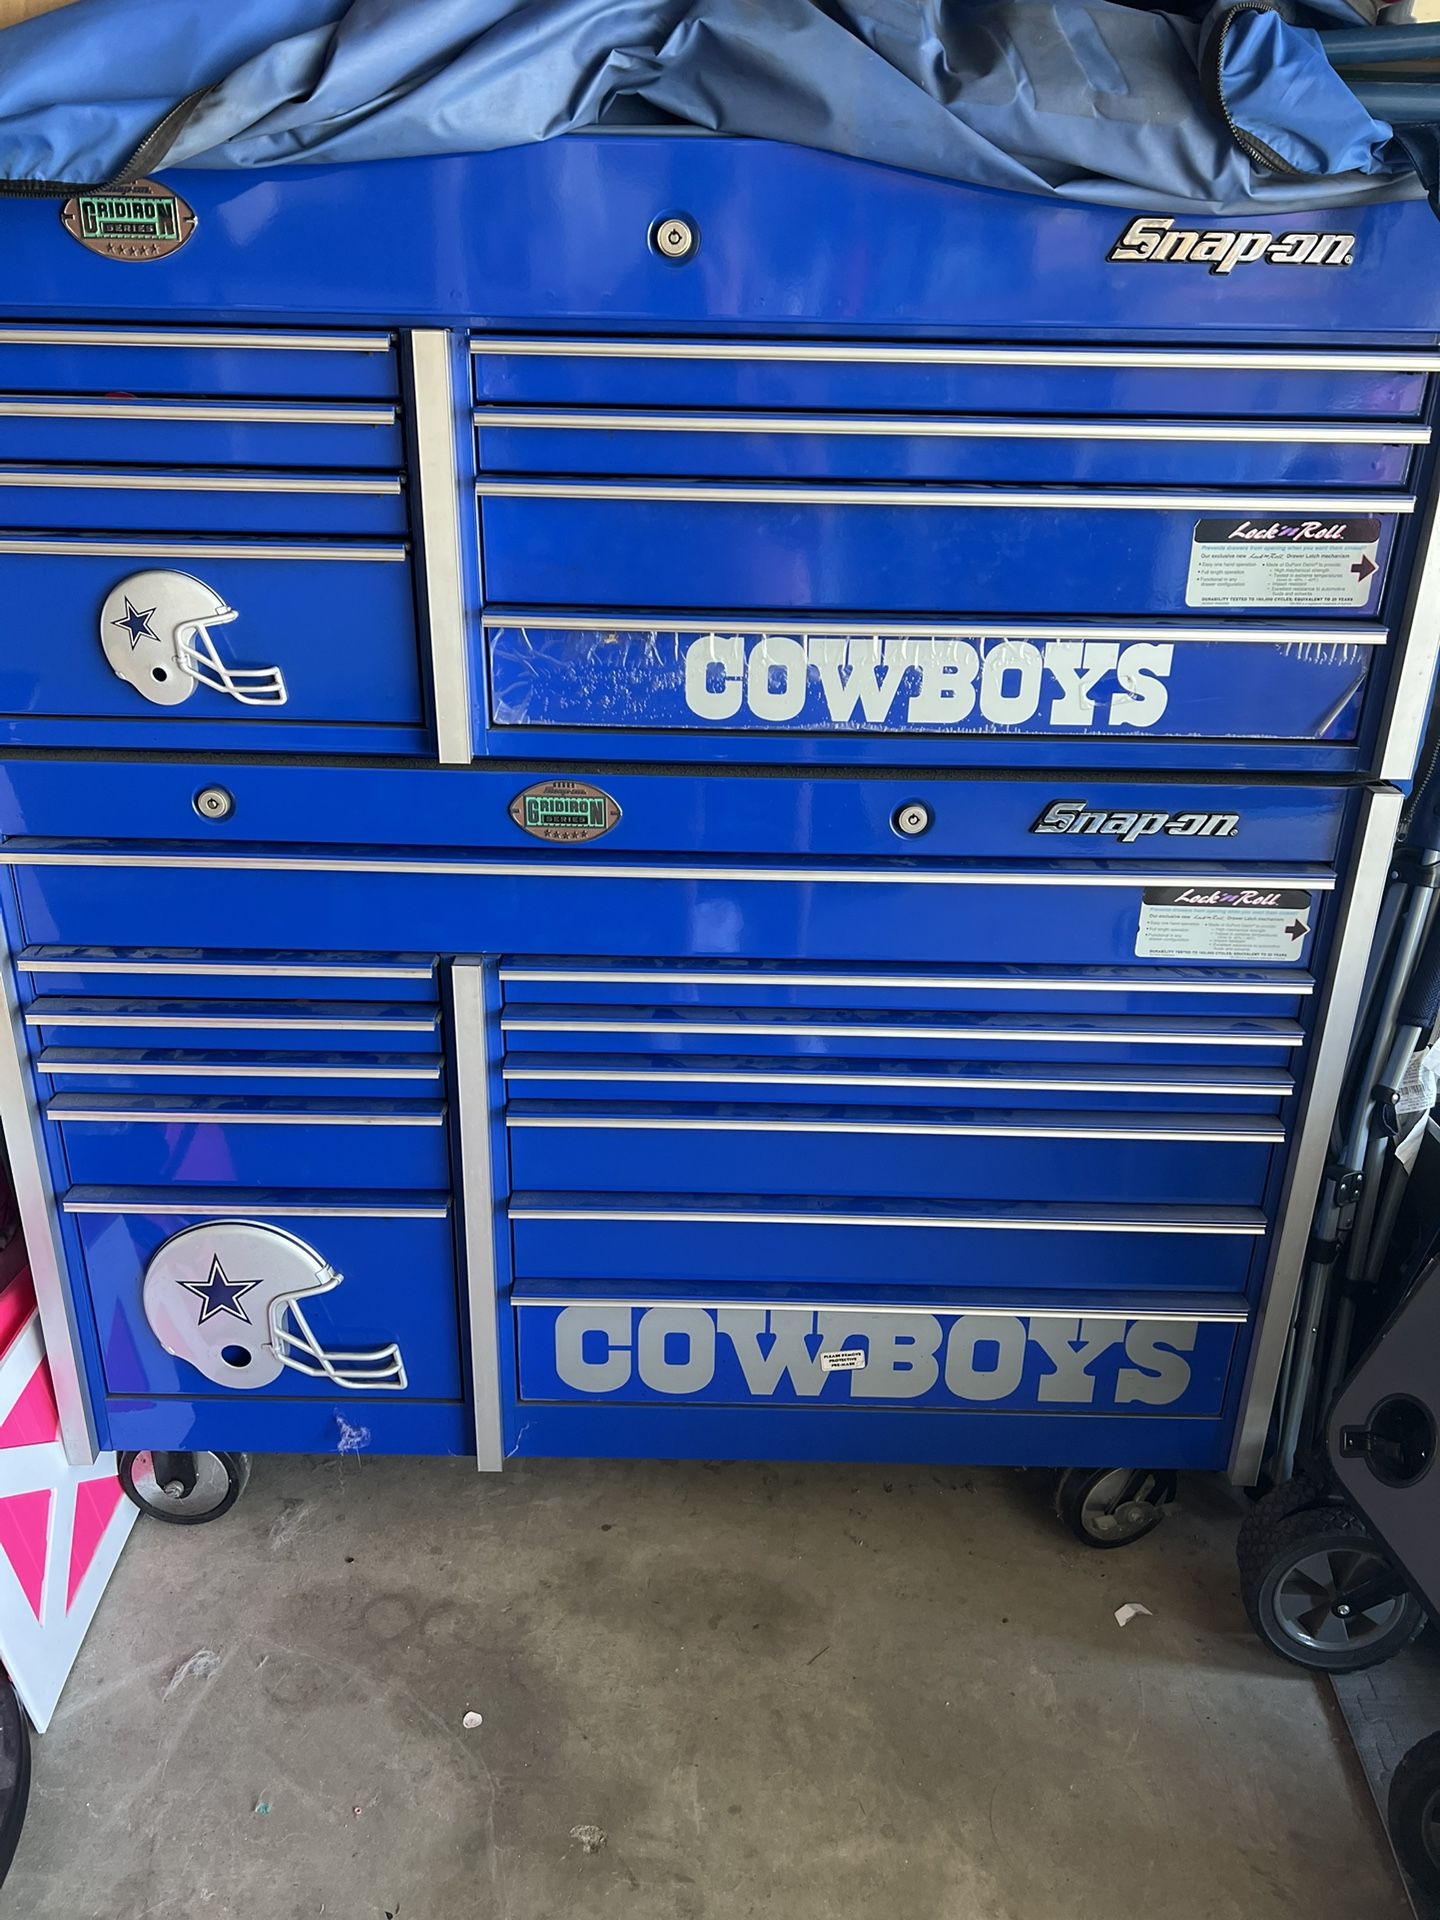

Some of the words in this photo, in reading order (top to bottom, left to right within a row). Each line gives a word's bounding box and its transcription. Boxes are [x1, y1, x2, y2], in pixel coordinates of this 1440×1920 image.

[81, 200, 176, 235] GRIDIRON
[105, 223, 154, 233] SERIES
[1228, 521, 1280, 540] Lock
[1292, 521, 1347, 541] Roll
[684, 634, 1174, 728] COWBOYS
[527, 799, 603, 825] GRIDIRON
[545, 815, 586, 823] SERIES
[1174, 888, 1221, 904] Lock
[1232, 890, 1281, 906] Roll
[554, 1304, 1199, 1405] COWBOYS
